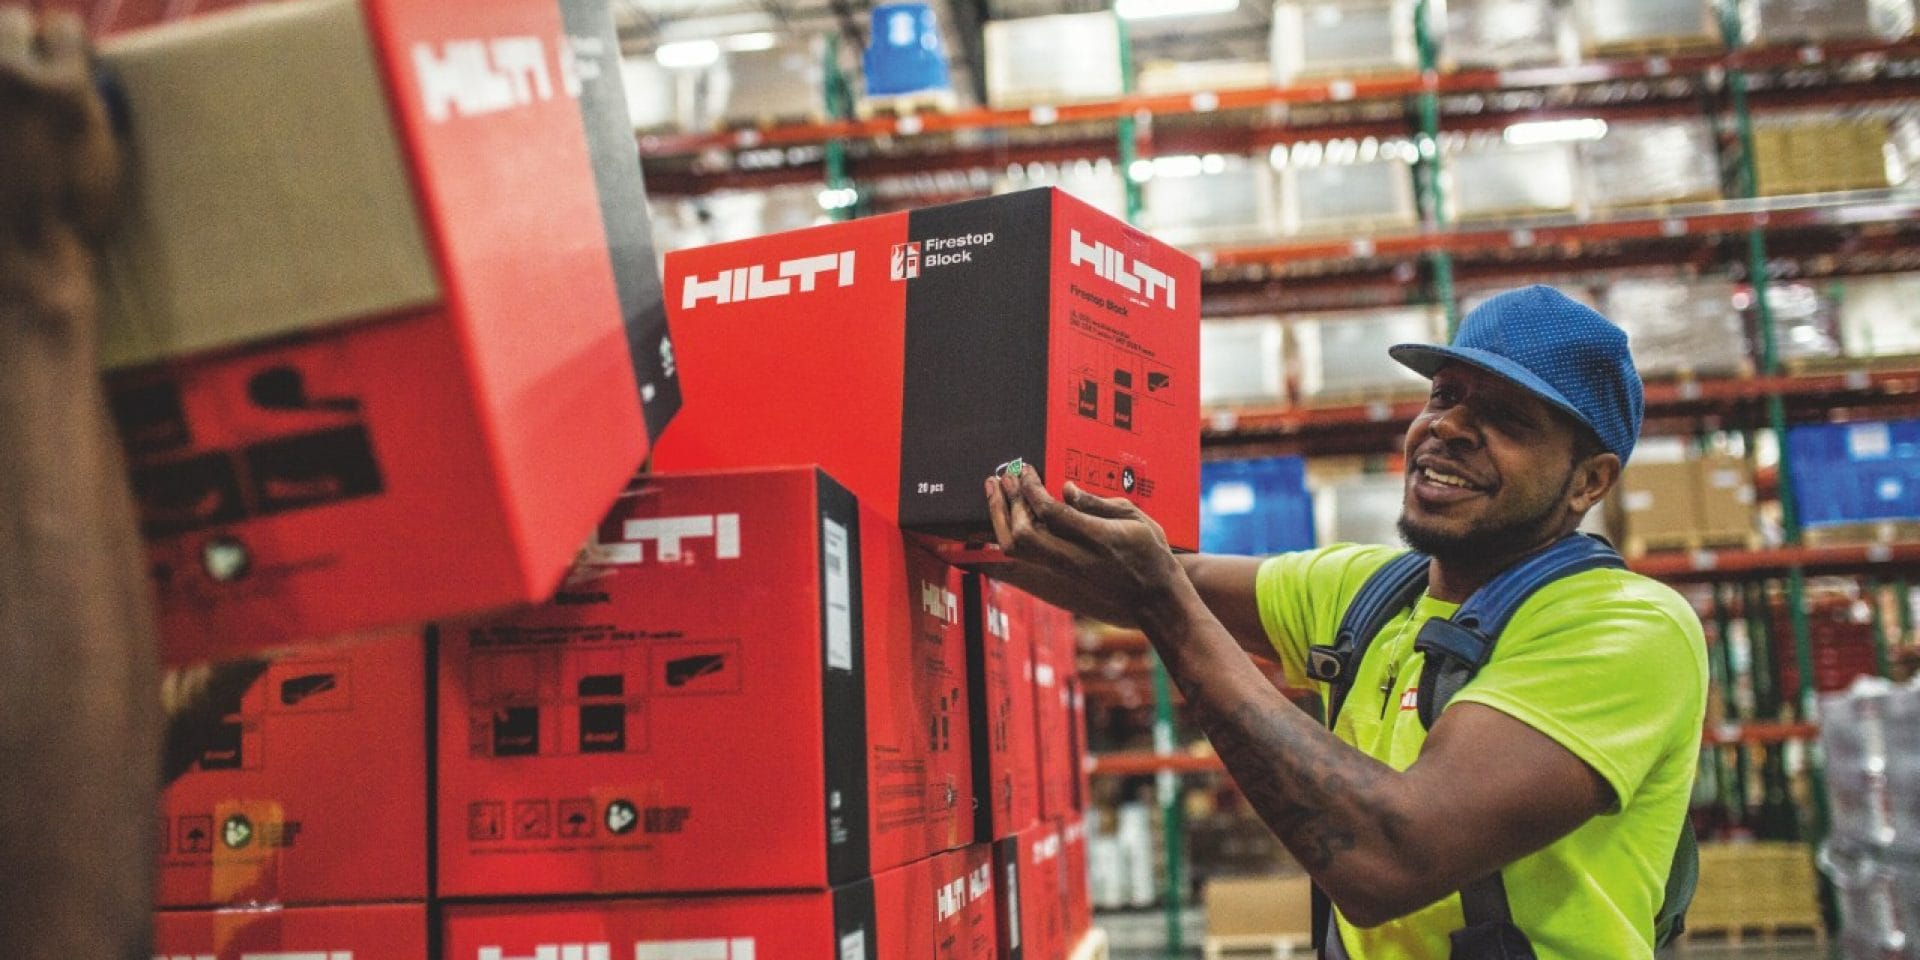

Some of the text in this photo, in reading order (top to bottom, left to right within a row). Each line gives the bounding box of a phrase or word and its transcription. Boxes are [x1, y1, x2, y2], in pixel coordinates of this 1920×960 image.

[414, 35, 553, 123] HILTI
[925, 232, 994, 251] Firestop
[925, 250, 972, 267] Block
[682, 250, 856, 310] HILTI
[1070, 229, 1176, 310] HILTI
[578, 513, 741, 565] LTI
[922, 579, 958, 625] HILTI
[937, 876, 966, 922] HILTI
